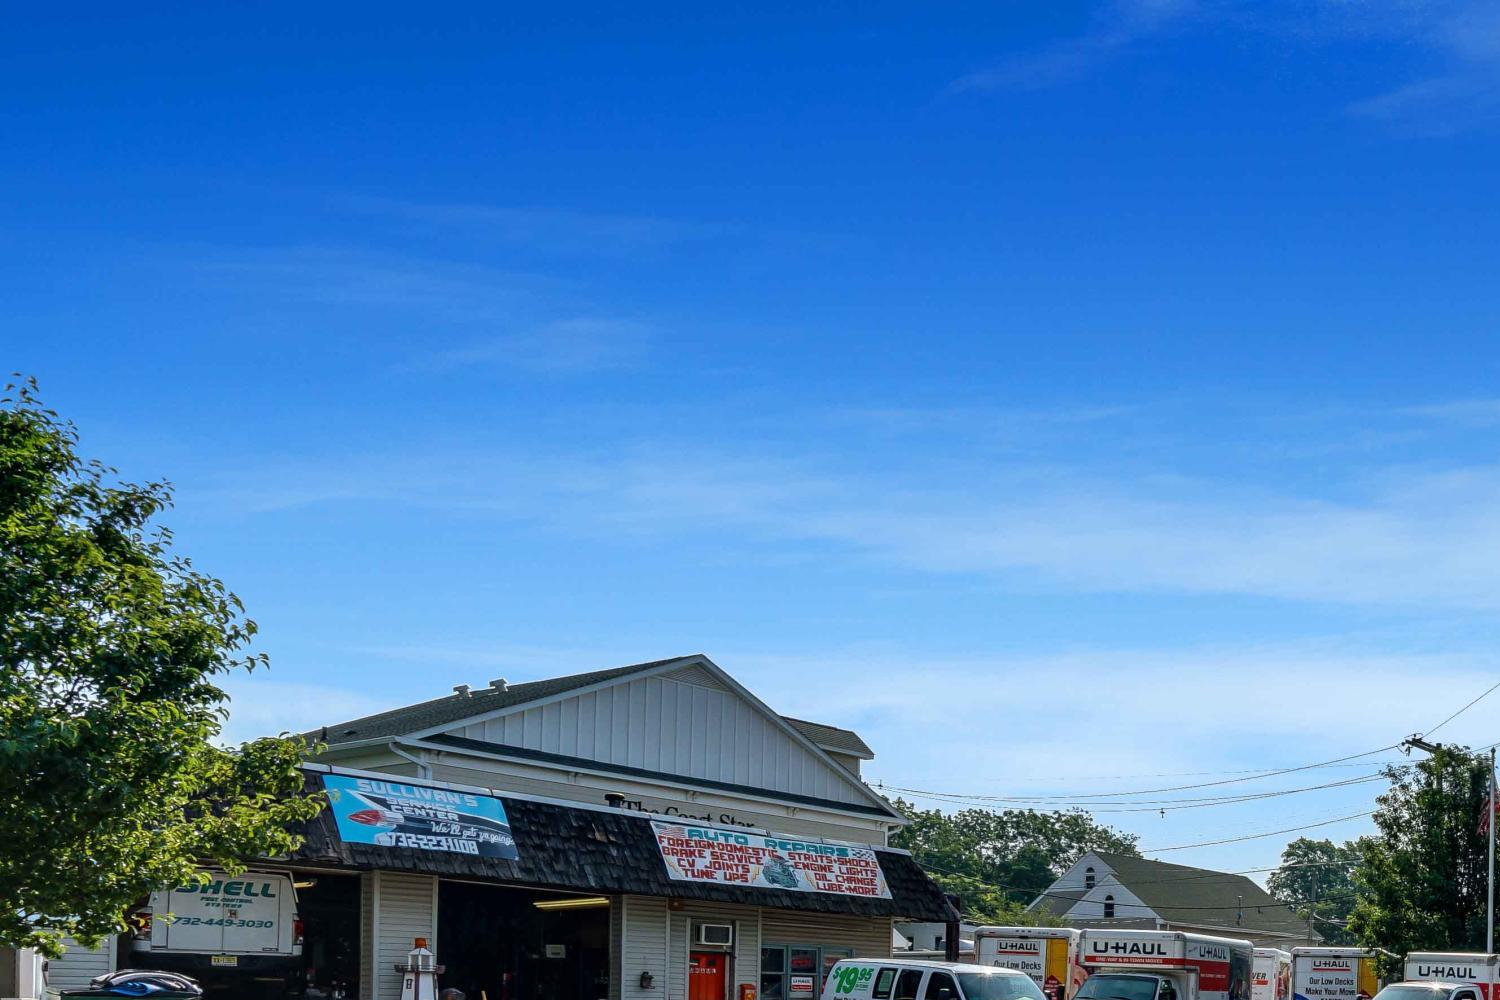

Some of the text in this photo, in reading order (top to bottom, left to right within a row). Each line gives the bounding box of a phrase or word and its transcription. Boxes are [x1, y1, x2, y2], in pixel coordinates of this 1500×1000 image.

[356, 779, 478, 807] SULLIVAN'S
[390, 805, 459, 821] CENTER
[687, 829, 849, 857] AUTO REPAIRS
[662, 846, 764, 866] BRAKE SERVICE
[677, 858, 750, 874] CV JOINTS
[794, 862, 877, 878] ENGINE LIGHTS
[682, 868, 749, 883] TUNE UPS
[814, 872, 878, 887] OIL CHANGE
[175, 878, 277, 898] SHELL
[173, 916, 274, 929] 732-449-3030
[1093, 941, 1167, 955] U-HAUL
[1006, 961, 1020, 969] Low
[1021, 961, 1042, 971] Decks
[1418, 965, 1477, 979] U-HAUL
[1309, 977, 1354, 986] Our Low Decks
[1305, 988, 1356, 996] Make Your Move
